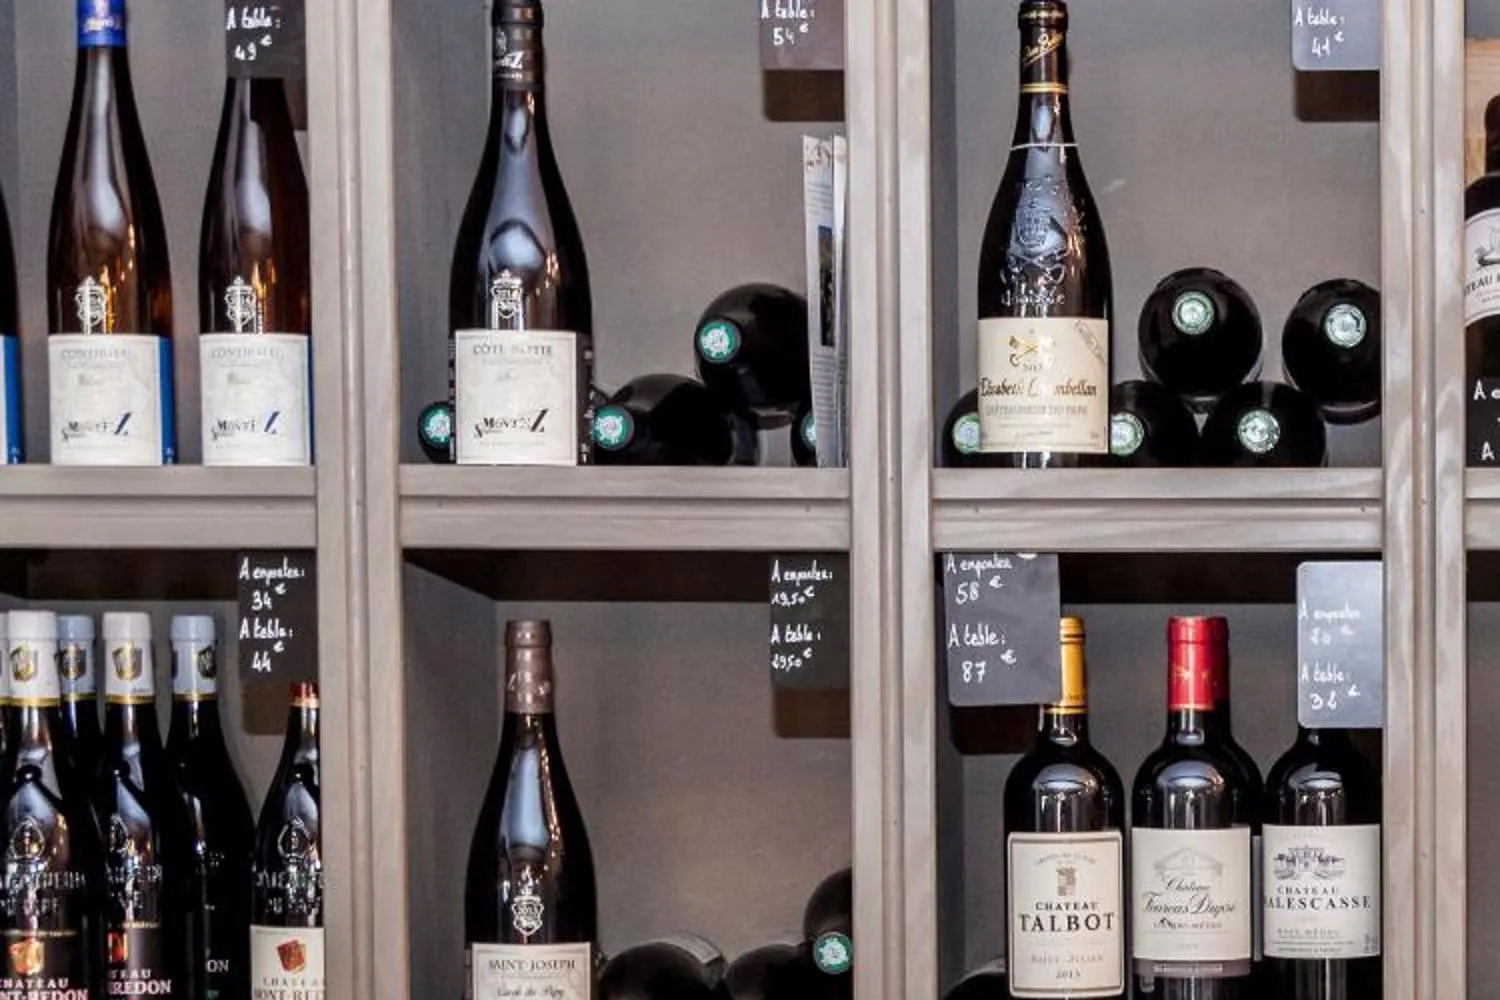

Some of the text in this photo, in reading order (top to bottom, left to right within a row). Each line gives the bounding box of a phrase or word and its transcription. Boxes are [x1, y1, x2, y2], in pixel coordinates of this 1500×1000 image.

[227, 7, 237, 30] A
[761, 0, 769, 19] A
[1295, 6, 1302, 26] A
[1474, 379, 1487, 400] A
[1481, 441, 1495, 460] A
[239, 556, 249, 580] A
[771, 559, 781, 583] A
[947, 553, 957, 574] A
[1299, 598, 1309, 621] A
[240, 617, 249, 641] A
[771, 624, 781, 645] A
[948, 623, 960, 649] A
[1301, 662, 1309, 683] A
[1019, 912, 1116, 933] TALBOT
